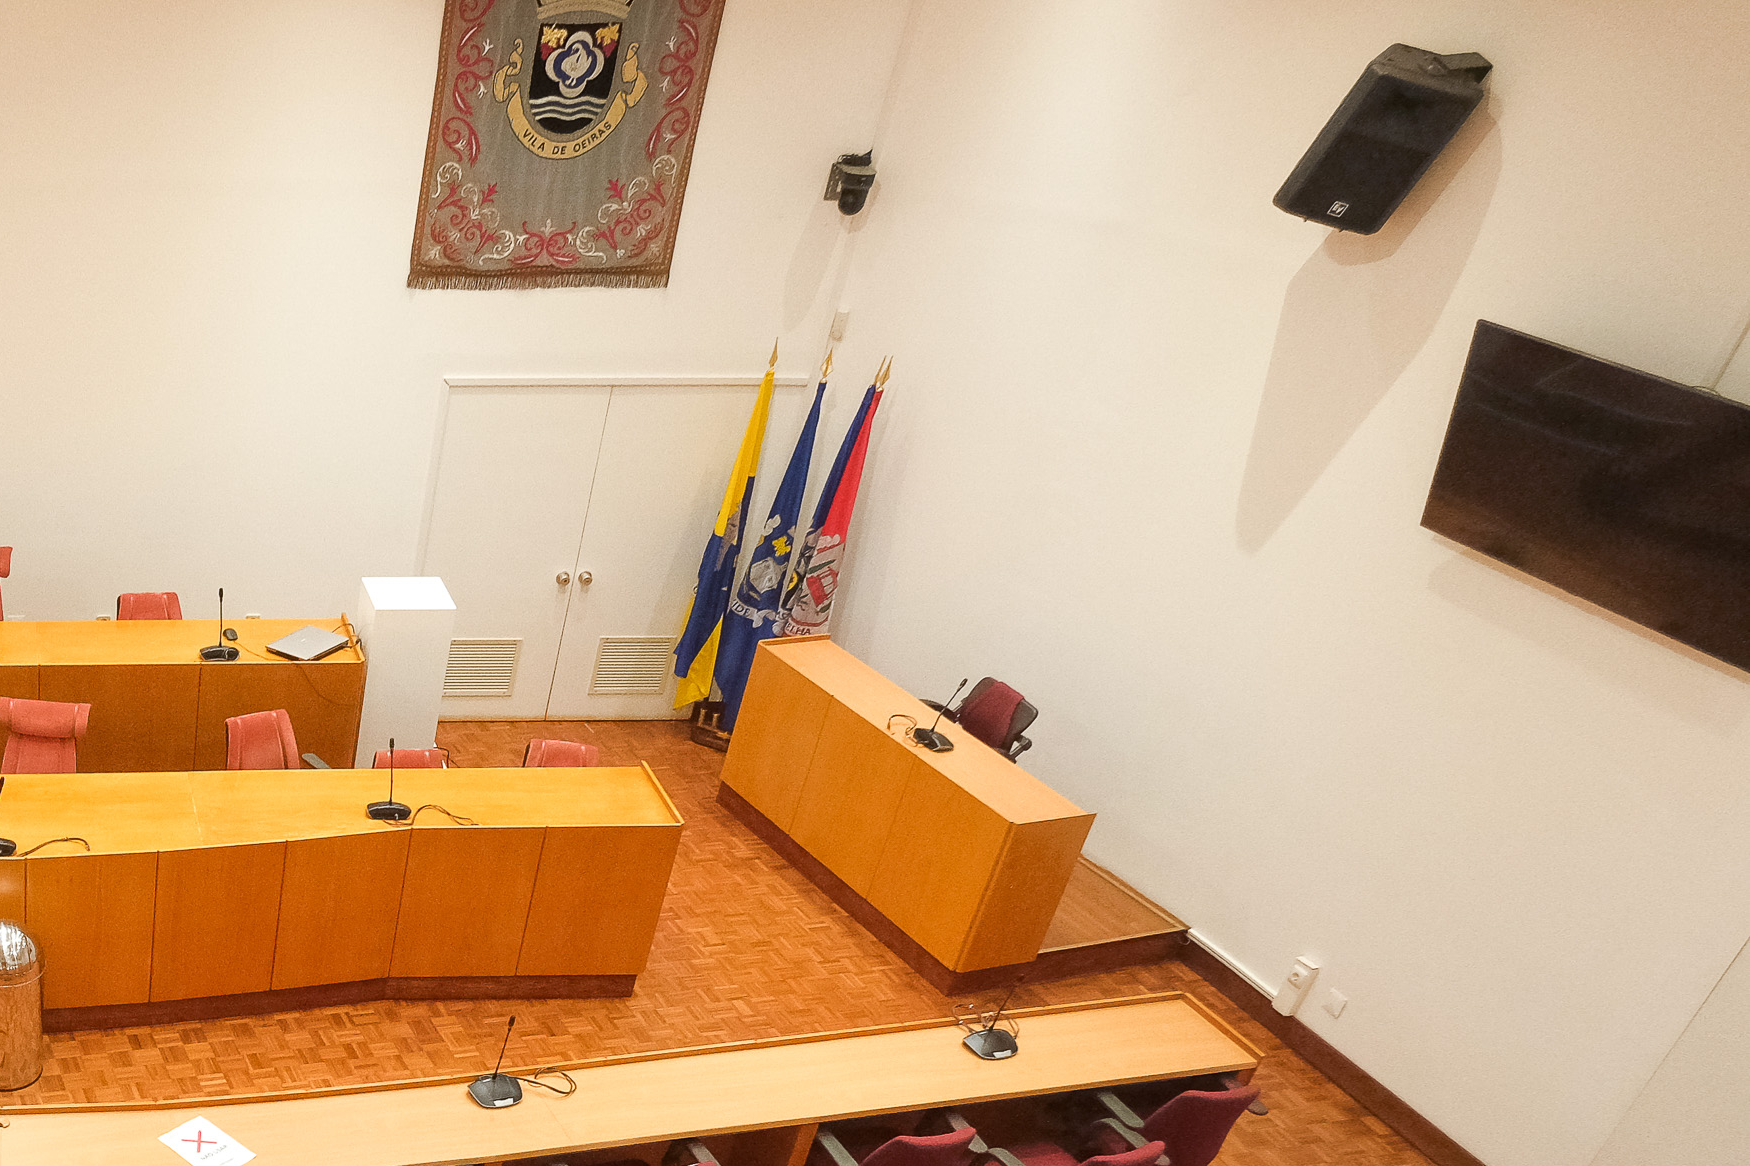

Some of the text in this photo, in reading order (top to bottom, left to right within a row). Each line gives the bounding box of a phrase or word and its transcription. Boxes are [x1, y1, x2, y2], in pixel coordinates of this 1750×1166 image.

[522, 121, 612, 155] VILA DE OEIRAS
